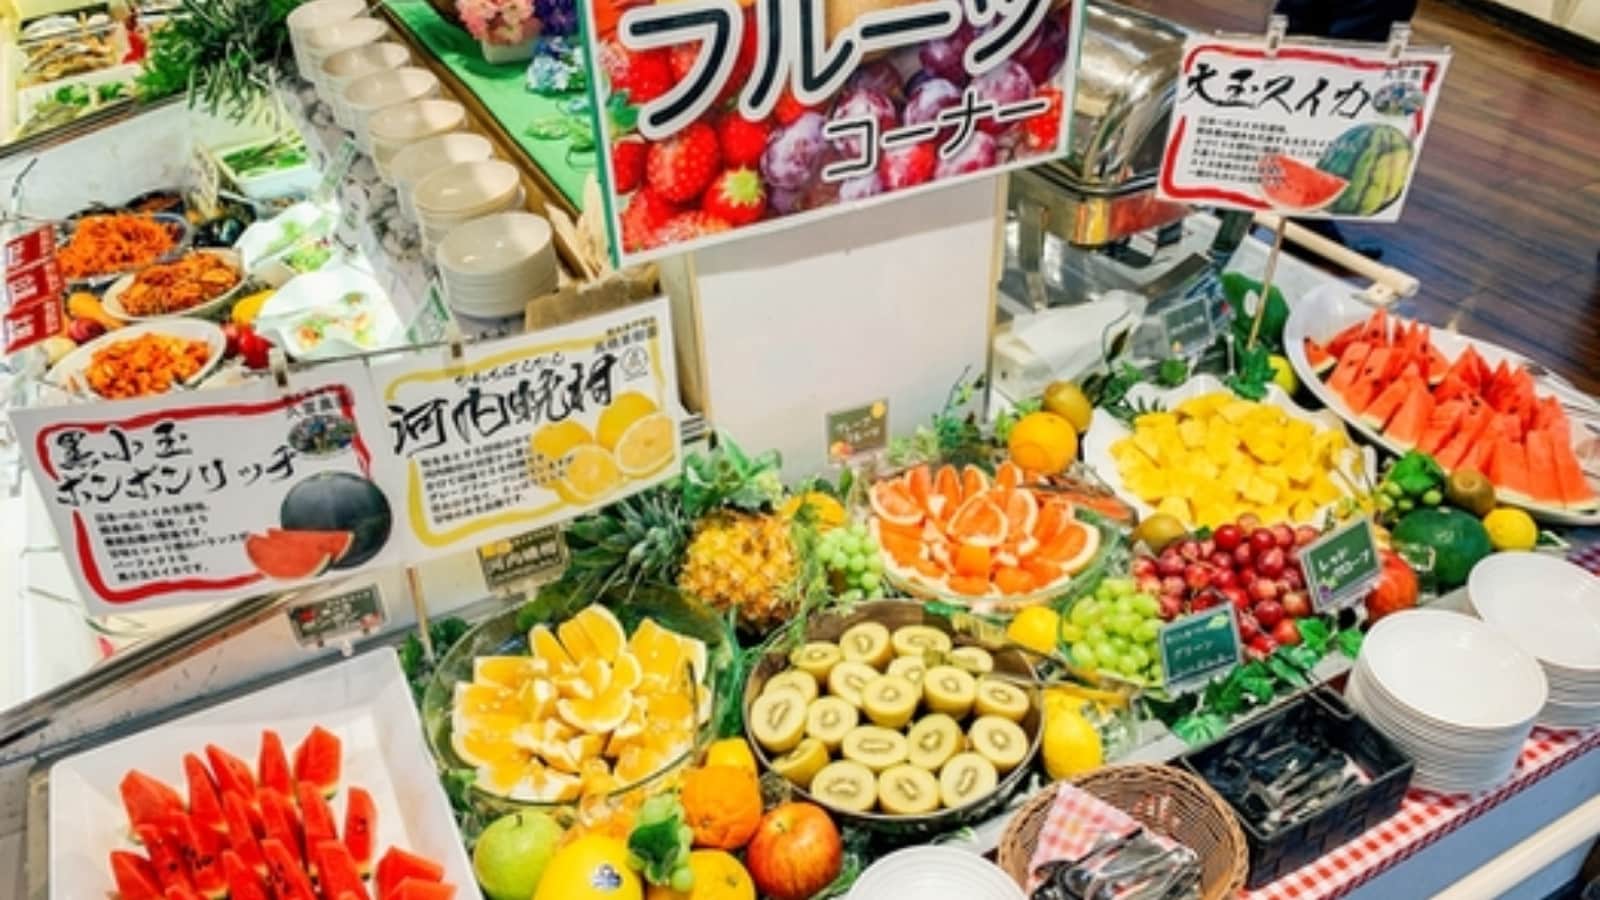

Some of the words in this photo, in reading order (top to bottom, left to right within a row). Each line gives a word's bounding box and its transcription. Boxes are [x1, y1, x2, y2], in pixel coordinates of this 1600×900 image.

[622, 0, 1052, 138] フルーツ
[1186, 63, 1371, 119] 大玉スイカ
[824, 90, 1050, 181] コーナー
[55, 421, 193, 471] 黒小玉
[387, 353, 618, 455] 河内晩柑
